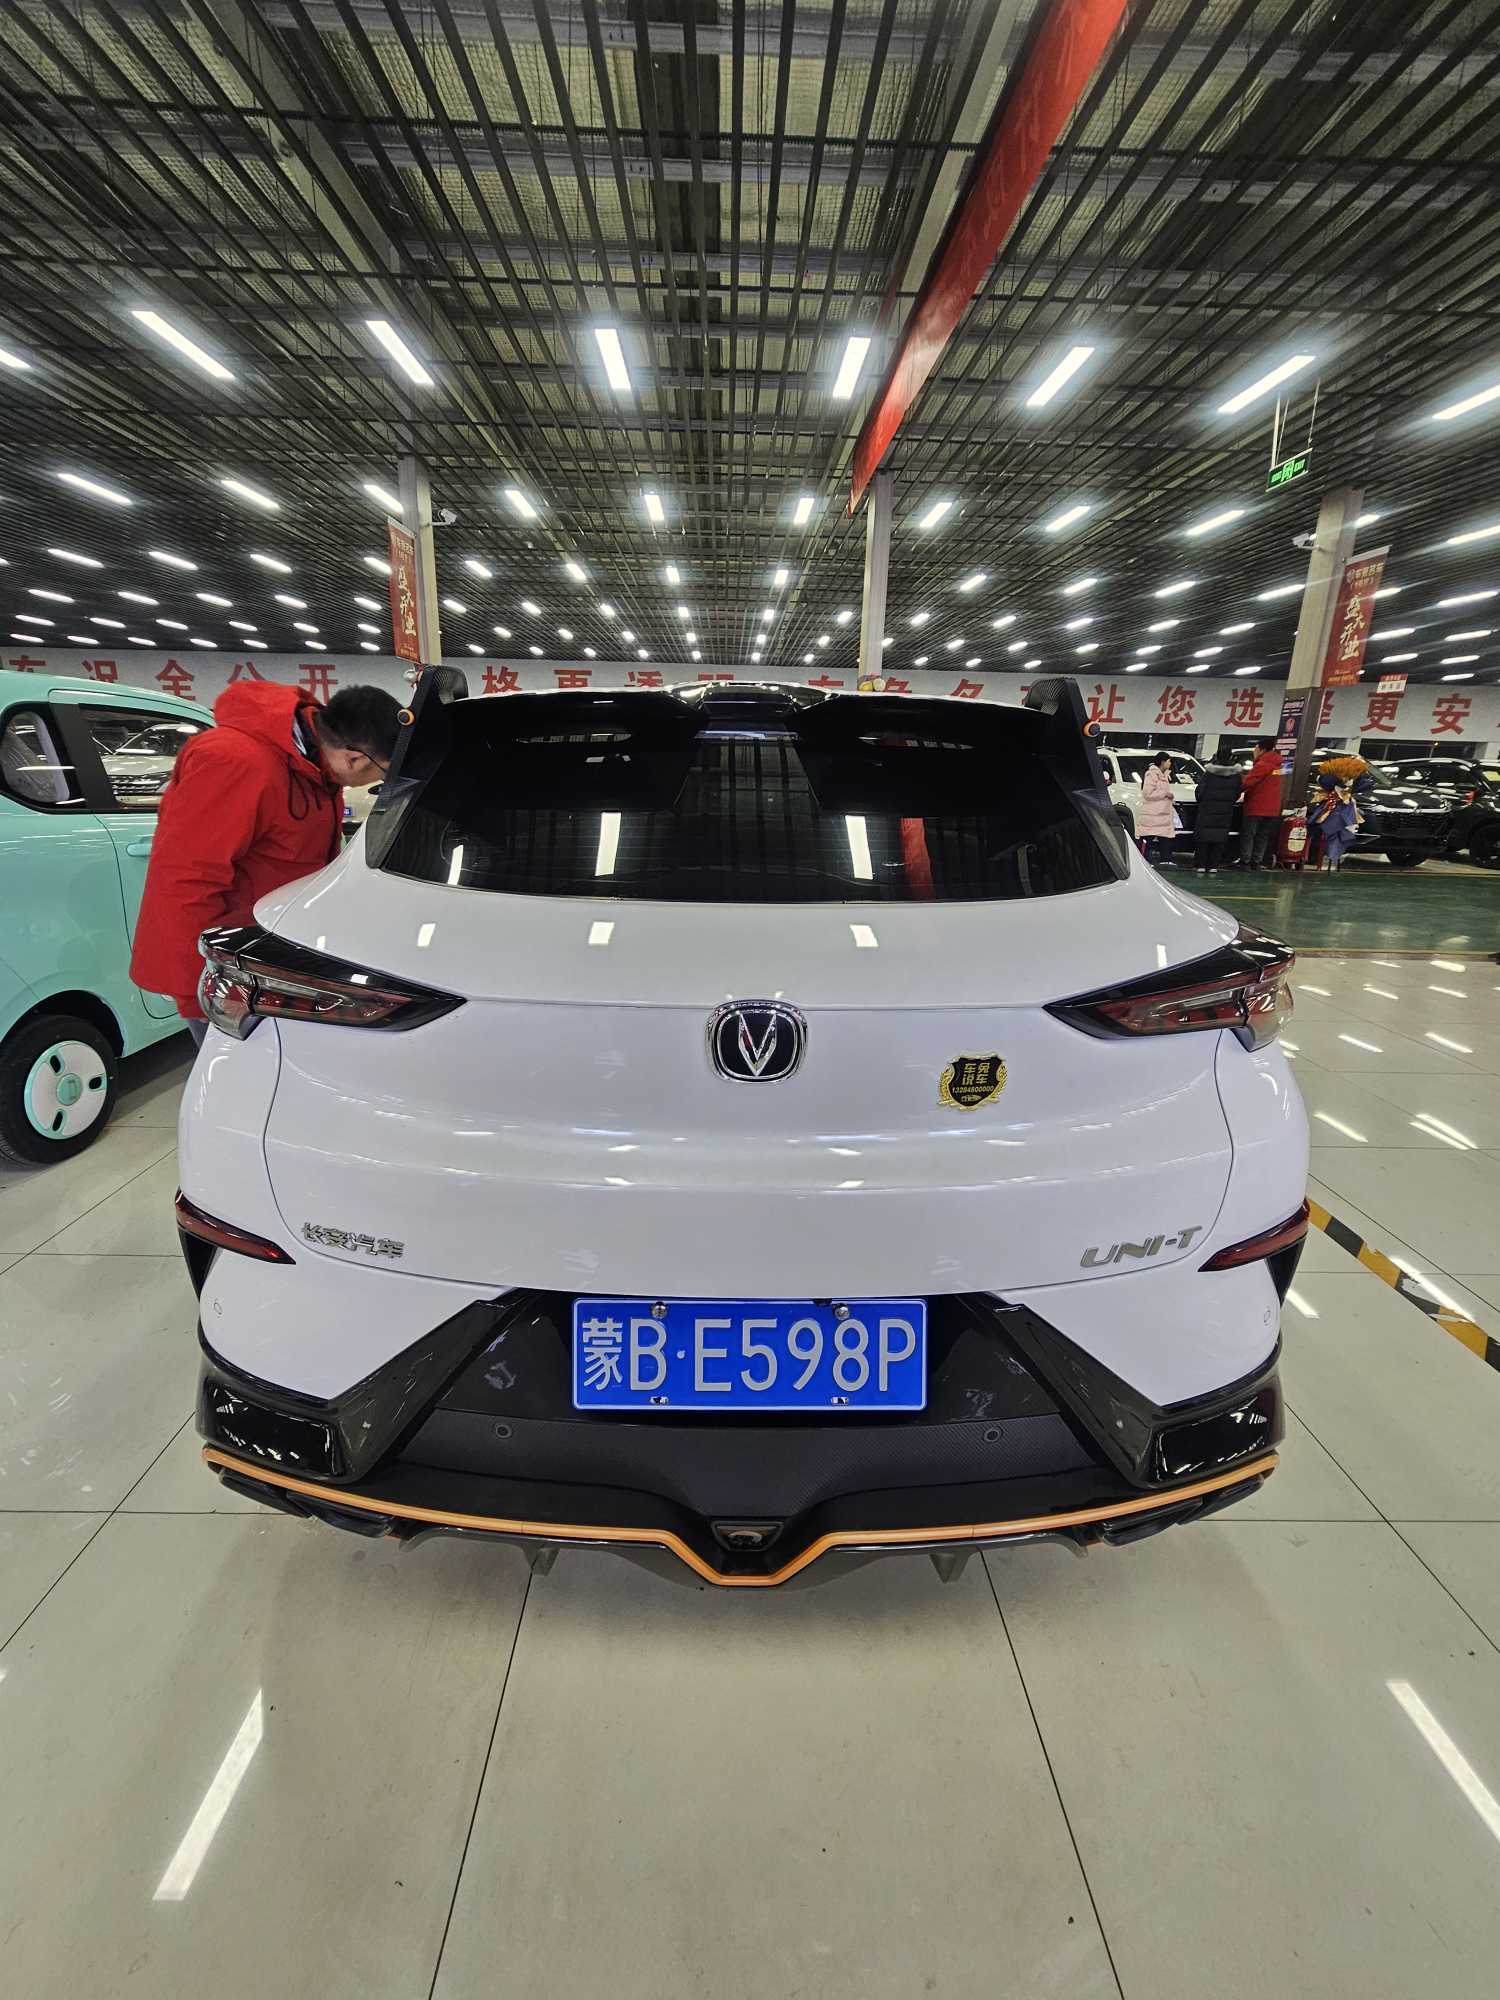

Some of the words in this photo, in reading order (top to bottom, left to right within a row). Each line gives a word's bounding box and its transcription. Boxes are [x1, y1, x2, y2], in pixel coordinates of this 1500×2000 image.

[301, 1222, 405, 1259] 长安汽车
[1080, 1225, 1203, 1268] UNI-T
